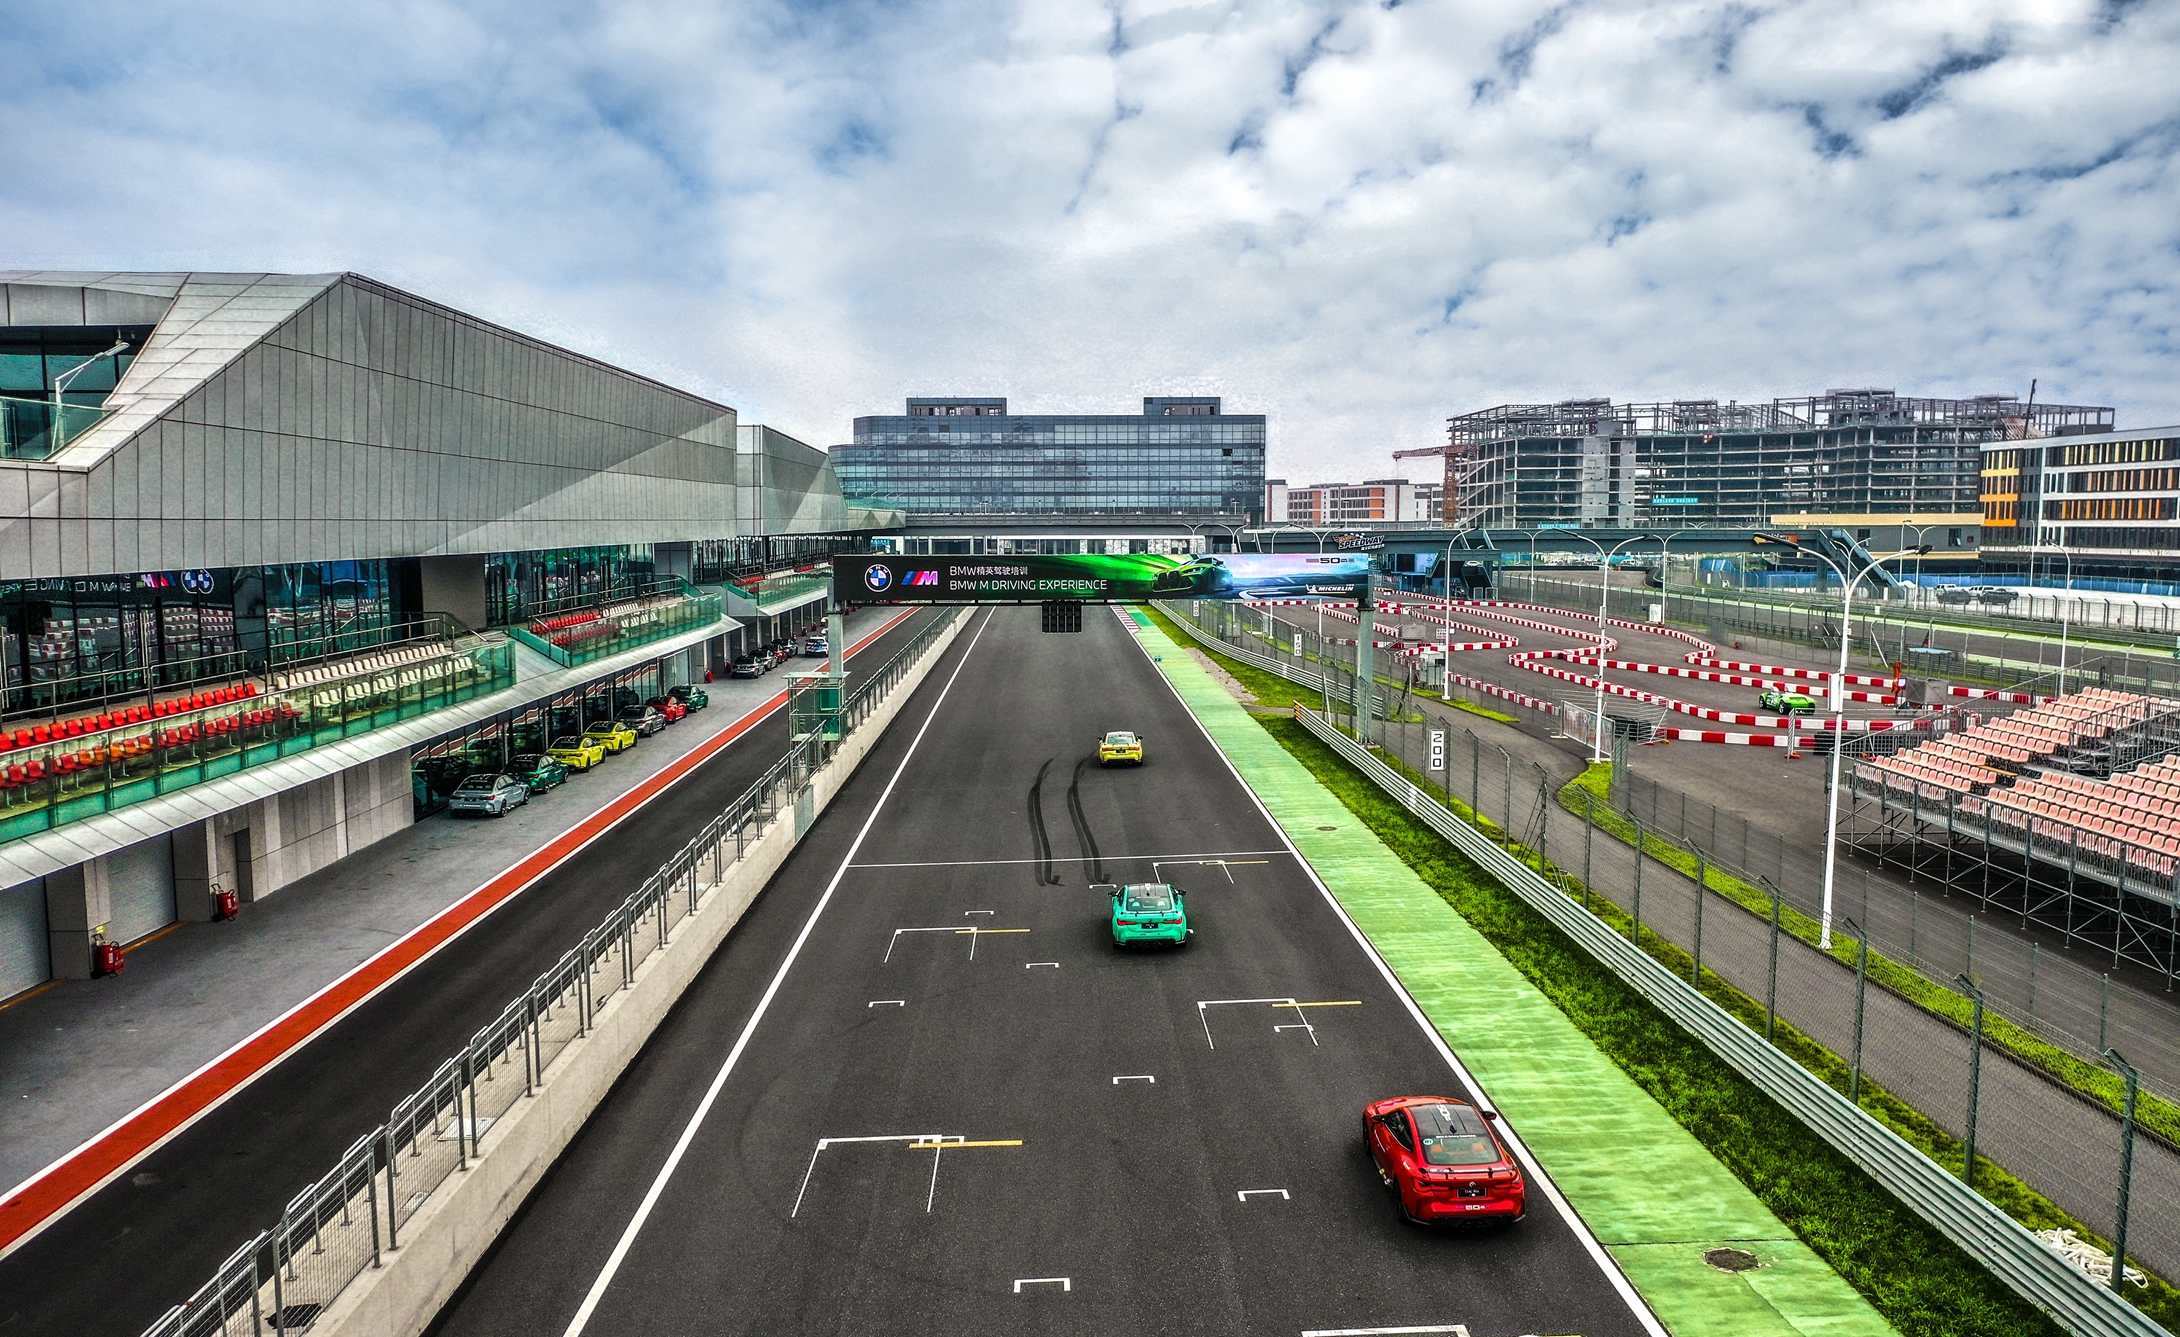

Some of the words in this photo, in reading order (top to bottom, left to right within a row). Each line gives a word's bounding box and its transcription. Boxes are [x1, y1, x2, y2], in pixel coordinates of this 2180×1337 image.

[1338, 535, 1384, 549] SPEEDWAY
[949, 580, 977, 590] BMW
[979, 580, 989, 590] M
[991, 580, 1036, 590] DRIVING
[1039, 580, 1108, 590] EXPERIENCE
[1433, 733, 1442, 767] 200
